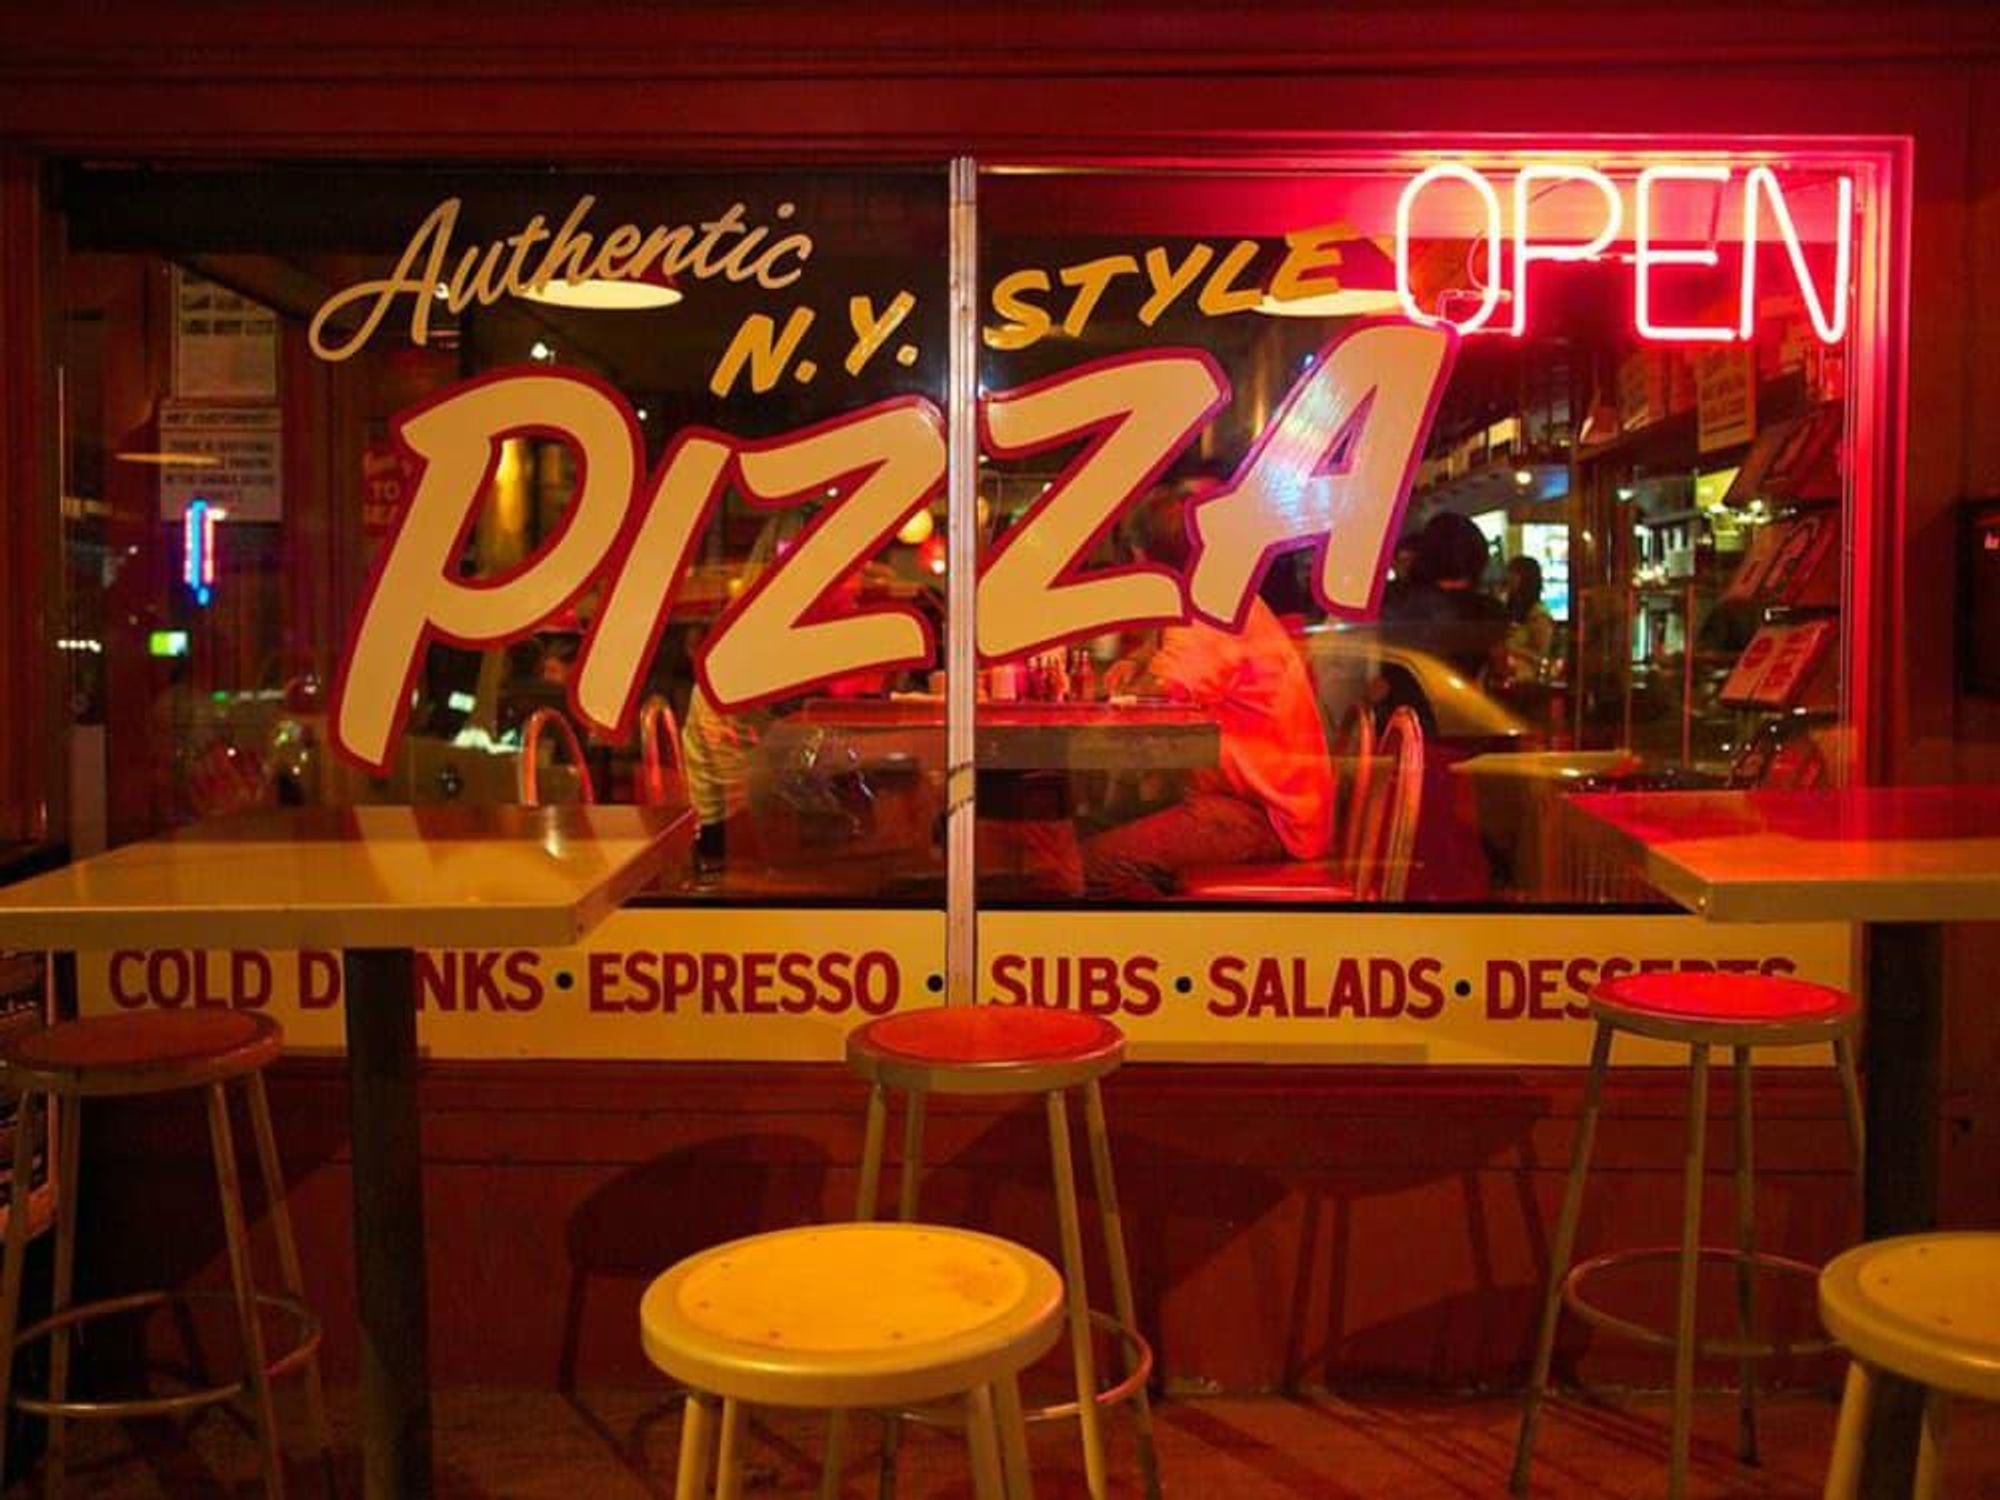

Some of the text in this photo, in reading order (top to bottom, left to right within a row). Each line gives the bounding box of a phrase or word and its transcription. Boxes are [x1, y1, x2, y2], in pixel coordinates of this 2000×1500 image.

[308, 195, 813, 361] Authentic
[709, 225, 1352, 398] N.Y. STYLE
[1395, 164, 1853, 344] OPEN
[330, 317, 1461, 774] PIZZA
[108, 948, 273, 1010] COLD
[298, 948, 544, 1014] DNKS
[588, 951, 900, 1016] ESPRESSO
[990, 955, 1163, 1017] SUBS
[1206, 956, 1444, 1020] SALADS
